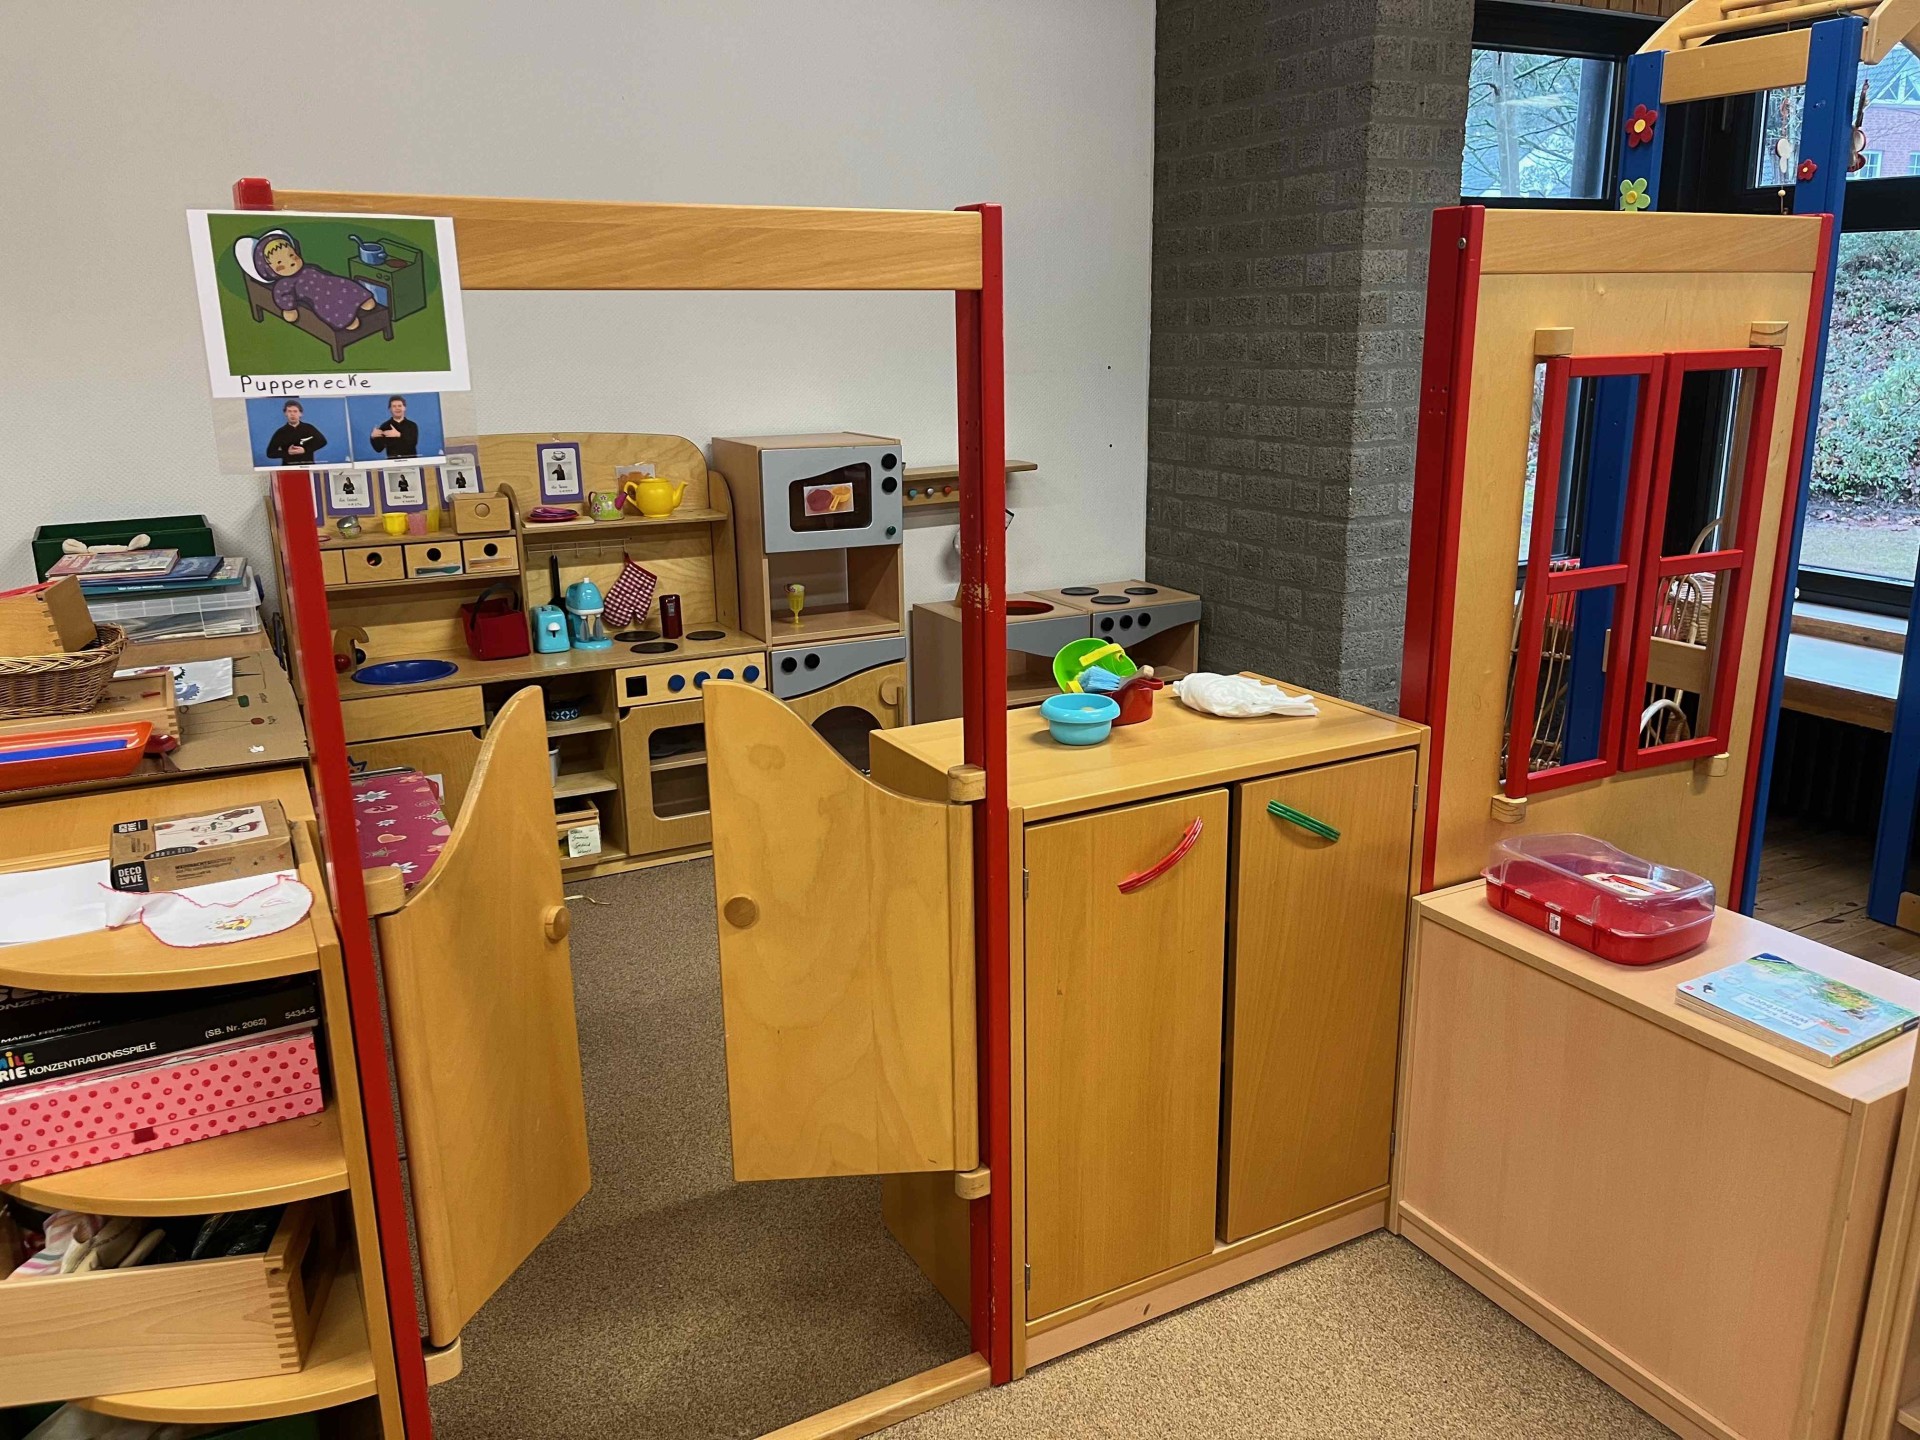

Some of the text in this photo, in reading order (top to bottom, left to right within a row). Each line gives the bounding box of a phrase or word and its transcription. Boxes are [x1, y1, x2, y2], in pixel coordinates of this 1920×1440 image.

[240, 374, 372, 394] Puppenecke
[118, 866, 142, 878] DECO
[29, 1041, 158, 1076] KONZENTRATIONSSPIELE
[226, 1024, 241, 1034] Nr.
[242, 1017, 267, 1030] 2062)
